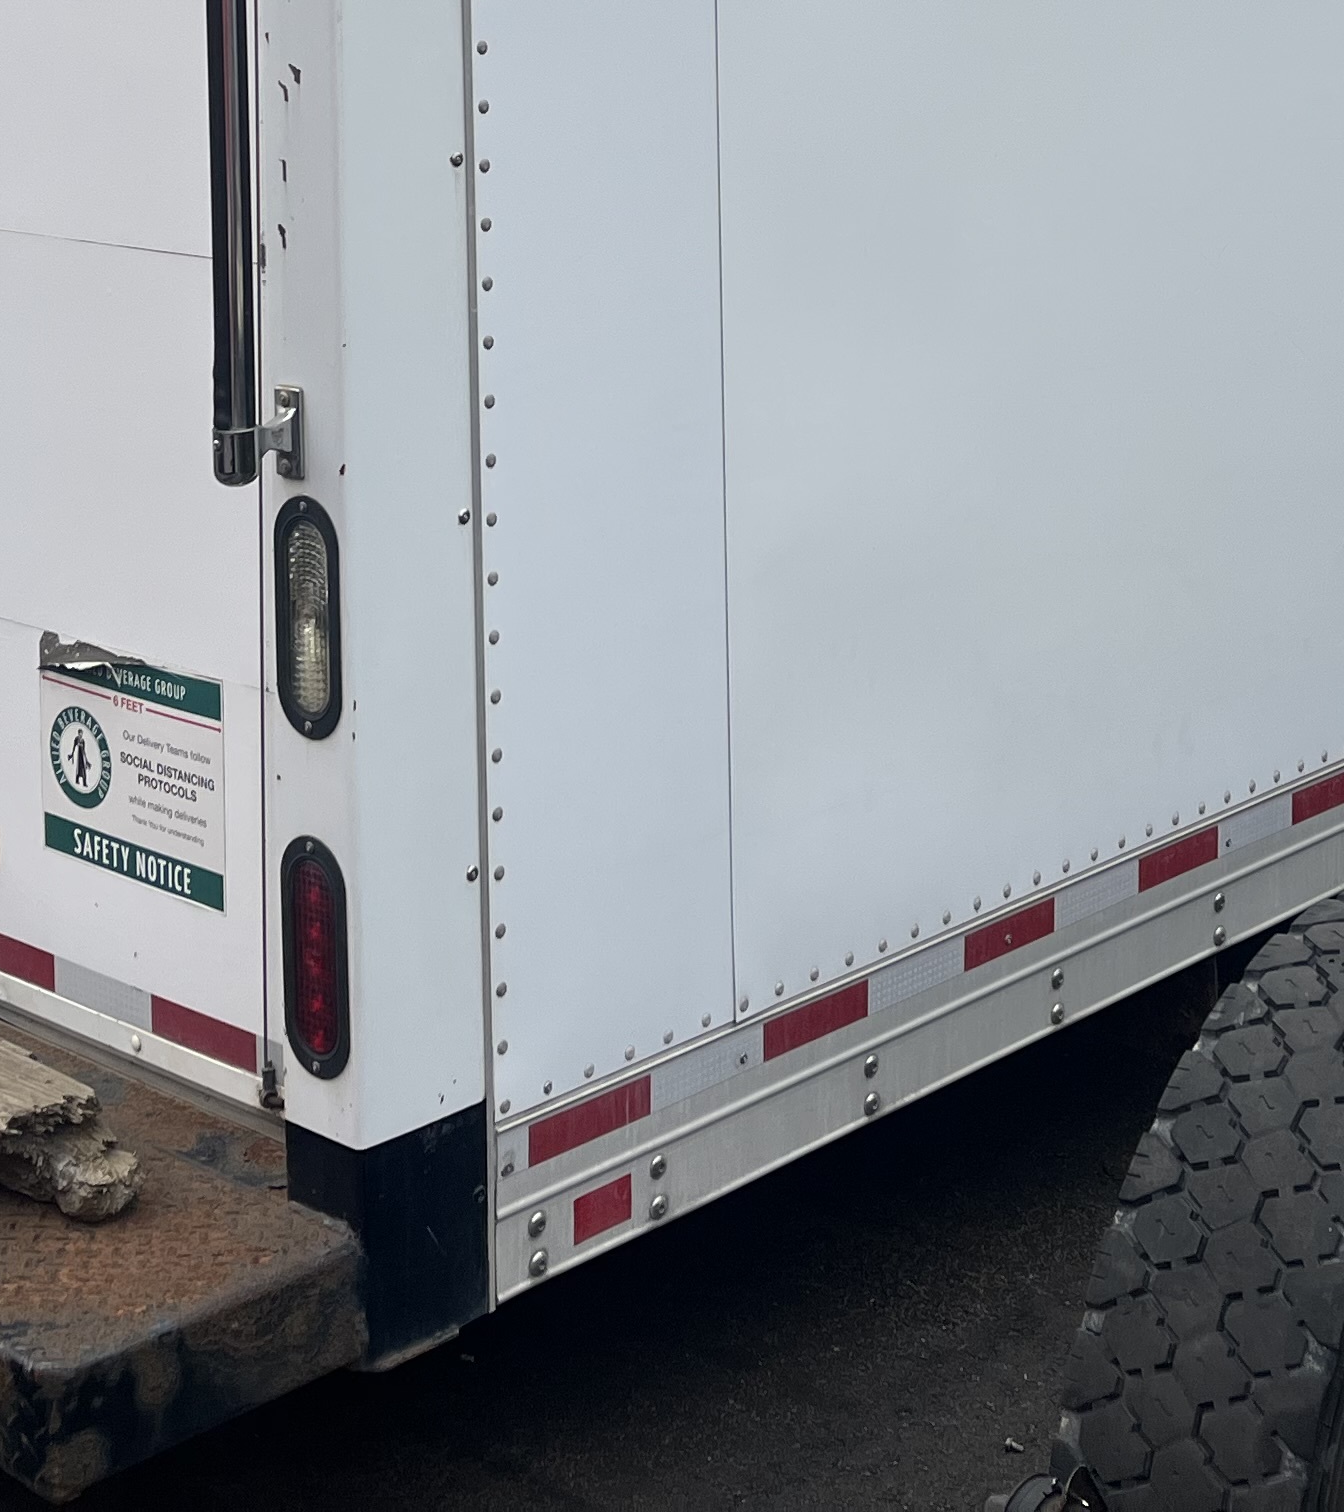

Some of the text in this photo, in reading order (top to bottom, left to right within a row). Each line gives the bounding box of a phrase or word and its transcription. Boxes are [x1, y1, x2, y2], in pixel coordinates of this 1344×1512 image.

[113, 694, 144, 714] 6 FEET
[154, 678, 186, 701] GROUP
[57, 708, 104, 741] BEVERAGE
[97, 750, 111, 799] GROUP
[122, 729, 211, 765] Our Delivery Teams follow
[120, 751, 215, 791] SOCIAL DISTANCING
[138, 773, 197, 802] PROTOCOLS
[128, 795, 207, 828] while making deliveries
[73, 828, 192, 894] SAFETY NOTICE
